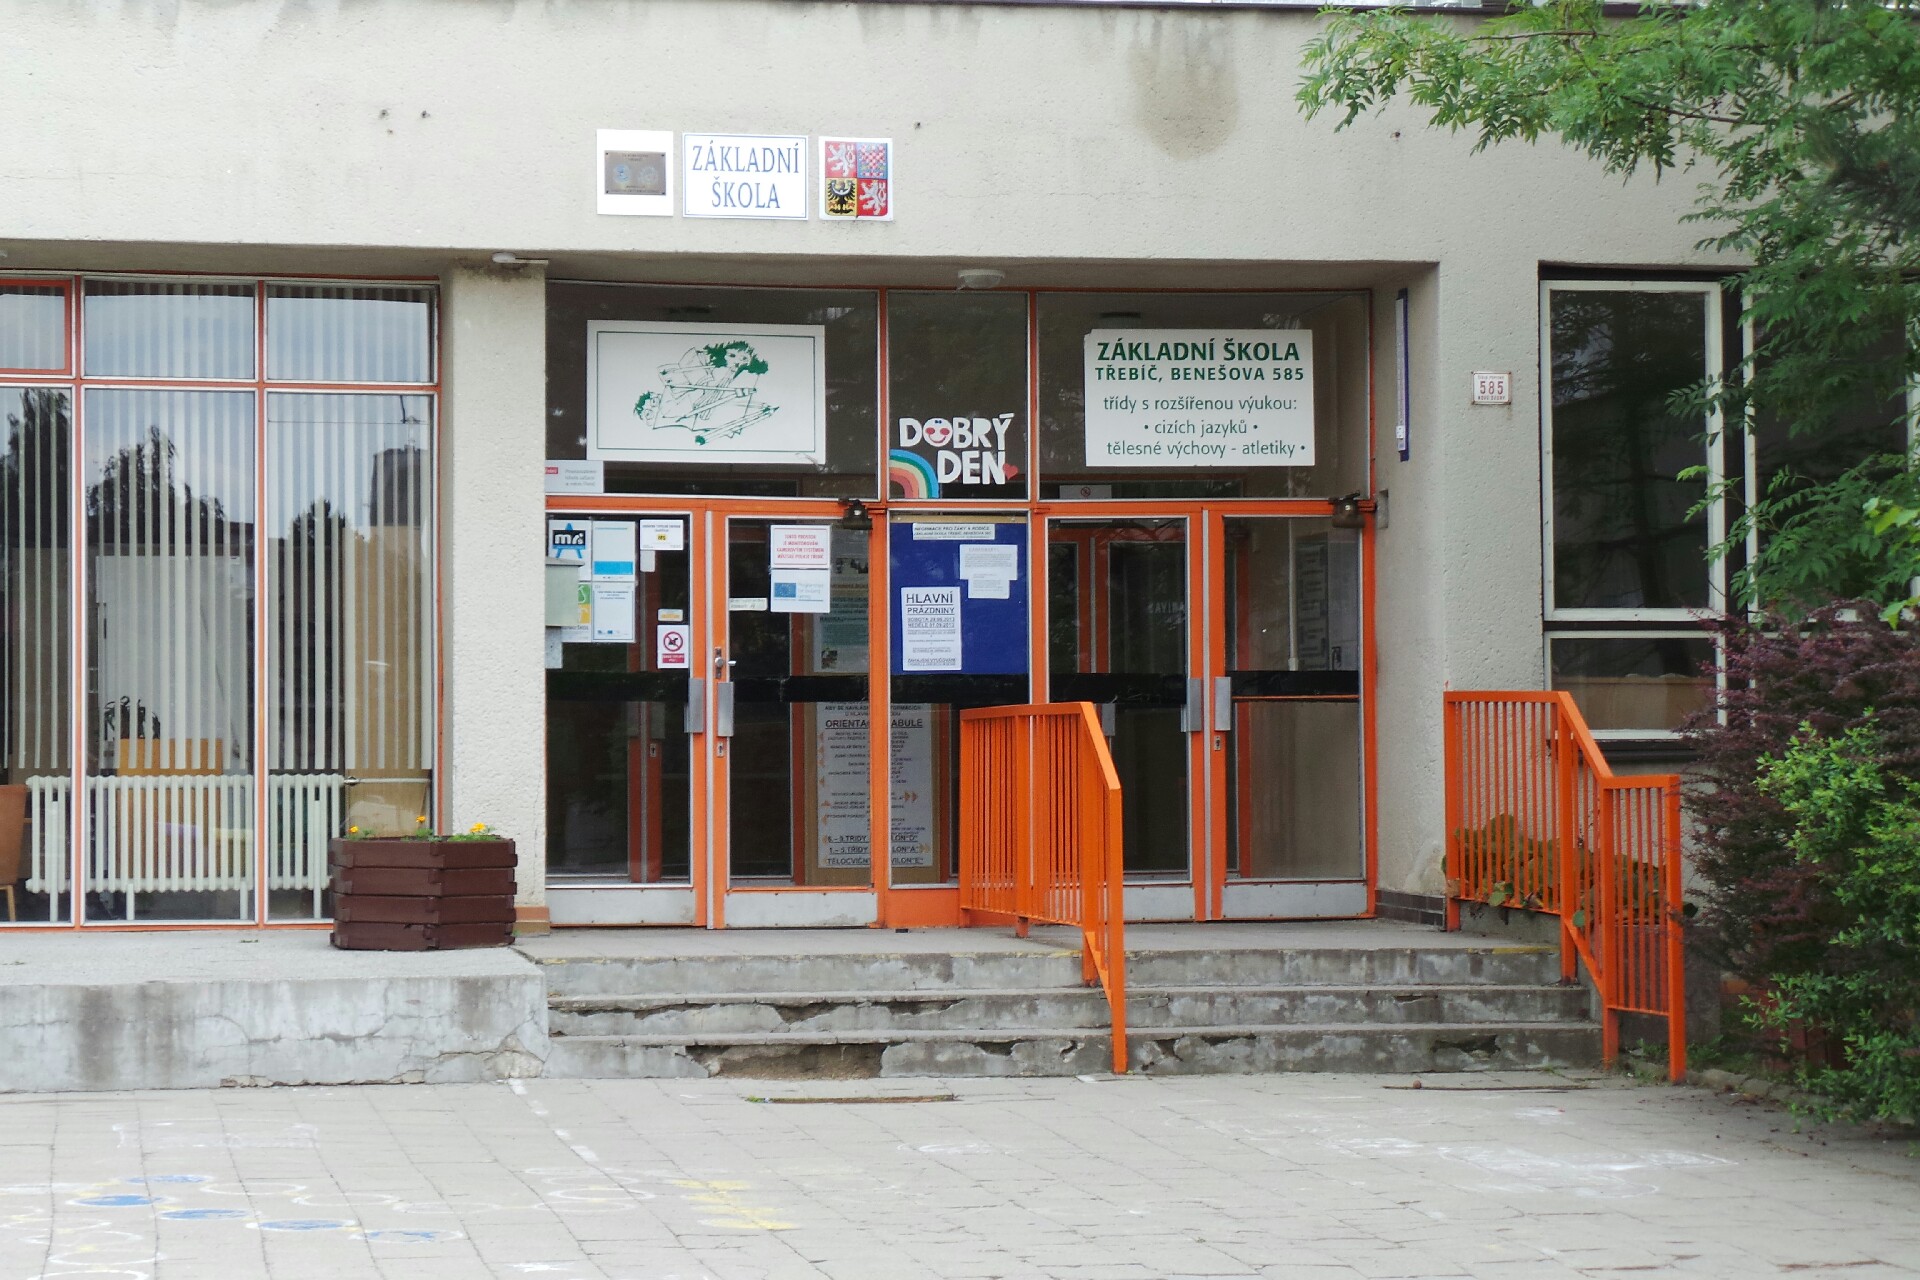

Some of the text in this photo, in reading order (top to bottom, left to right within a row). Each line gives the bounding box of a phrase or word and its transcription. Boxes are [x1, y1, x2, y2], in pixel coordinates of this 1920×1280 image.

[692, 140, 799, 174] ZÁKLADNÍ
[711, 176, 781, 209] ŠKOLA
[1097, 338, 1300, 361] ZÁKLADNÍ ŠKOLA
[1095, 364, 1304, 382] TŘEBÍČ, BENEŠOVA 585
[1480, 381, 1503, 394] 585
[1104, 395, 1297, 413] třídy s rozšířenou výukou:
[899, 413, 1015, 450] DOBRÝ
[1154, 419, 1247, 437] cizích jazyků
[1107, 440, 1161, 455] tělesné
[1166, 440, 1226, 458] výchovy
[1242, 440, 1295, 458] atletiky
[937, 450, 1006, 485] DEN
[906, 591, 953, 603] HLAVNÍ
[907, 605, 955, 614] PRÁZDNINY
[825, 719, 923, 728] ORIENTA ABULE
